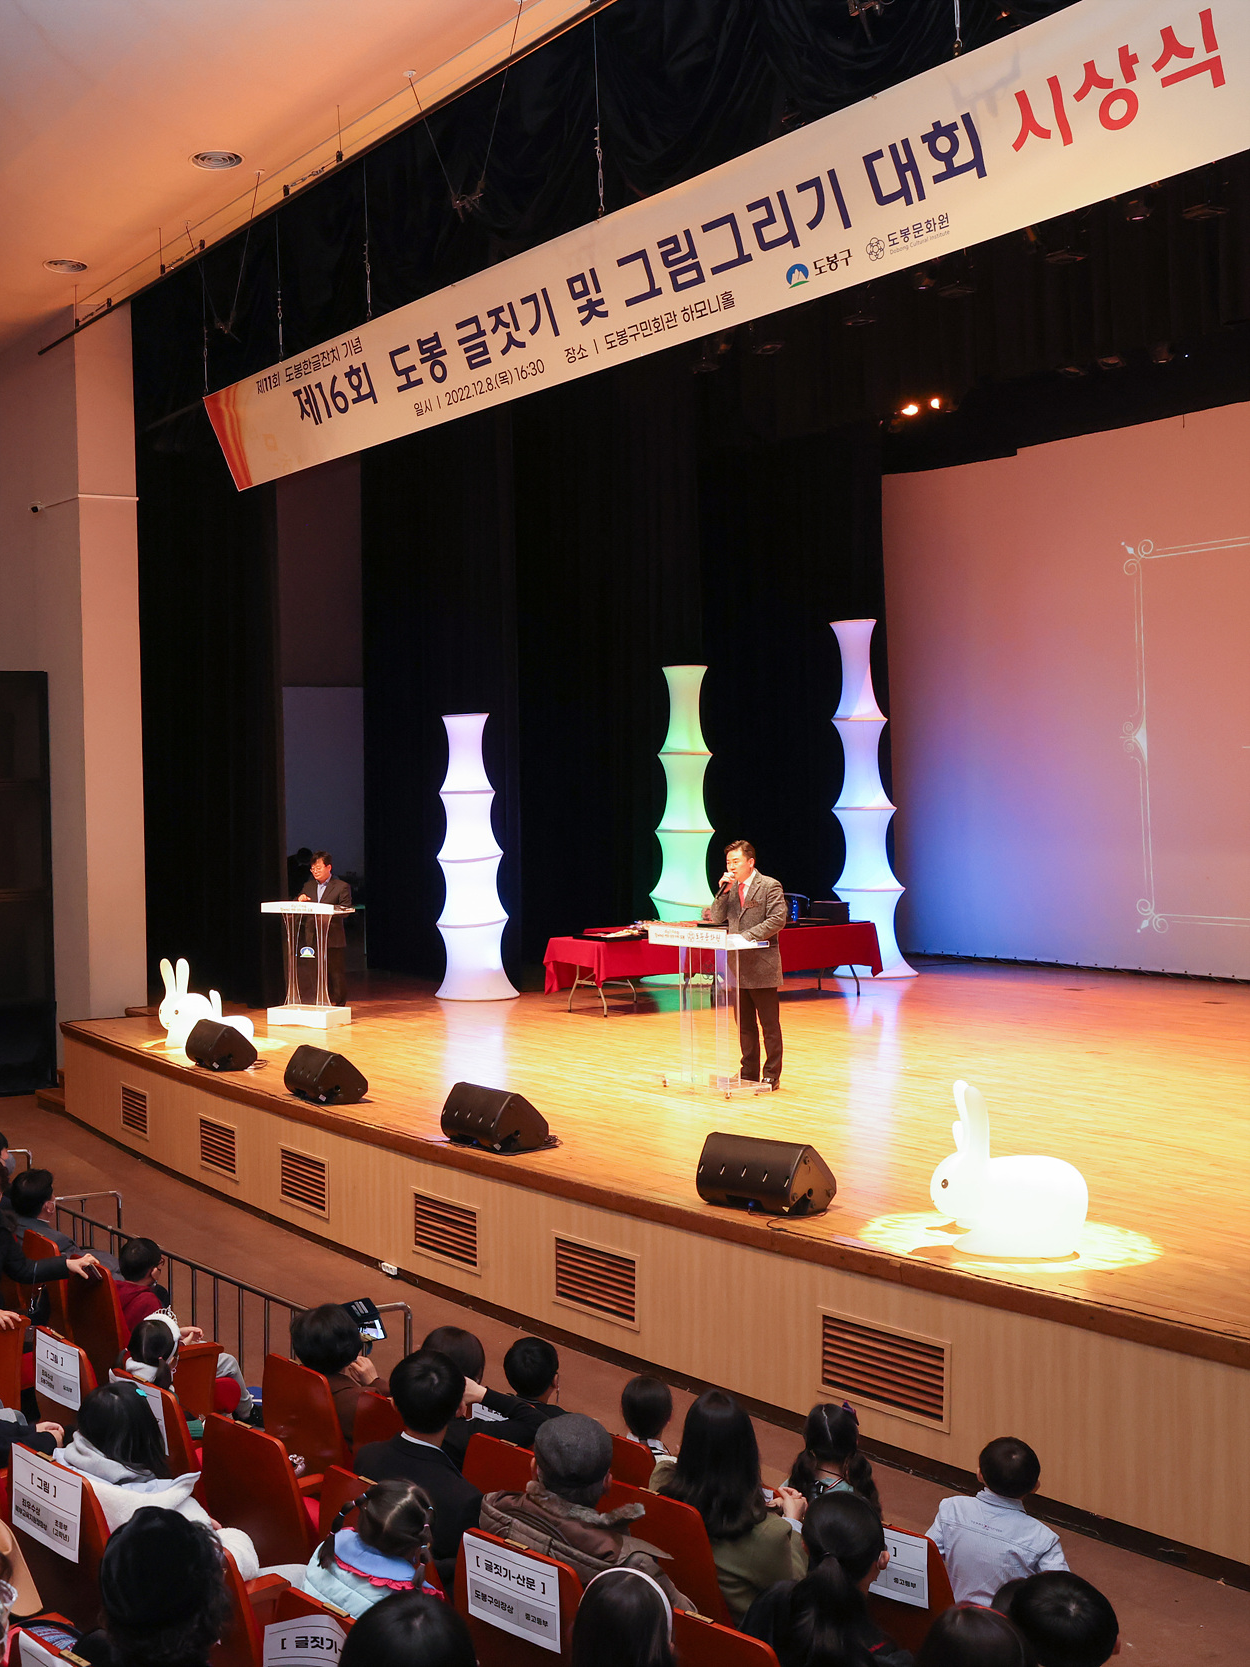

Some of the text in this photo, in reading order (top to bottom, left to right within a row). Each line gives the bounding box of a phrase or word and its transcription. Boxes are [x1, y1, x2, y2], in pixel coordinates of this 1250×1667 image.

[292, 8, 1226, 425] 제16회 도봉 글짓기 및 그림그리기 대회 시상식
[887, 212, 950, 248] 도봉문화원
[889, 230, 950, 255] Dobong Cultural Institute
[813, 249, 853, 277] 도봉구
[564, 343, 589, 364] 장소
[604, 311, 678, 351] 도봉구민회관
[681, 290, 736, 322] 하모니홀
[255, 336, 364, 395] 제11회 도봉한글잔치 기념
[413, 398, 433, 417] 일시
[445, 369, 514, 406] 2022.12.8.(목)
[514, 358, 545, 382] 16:30
[36, 1477, 50, 1494] 그림
[22, 1498, 41, 1517] 최우수상
[484, 1559, 536, 1591] 글짓기-산문
[474, 1589, 514, 1615] 도봉구의장상
[524, 1612, 549, 1628] 중고등부
[294, 1635, 343, 1654] 글짓기-
